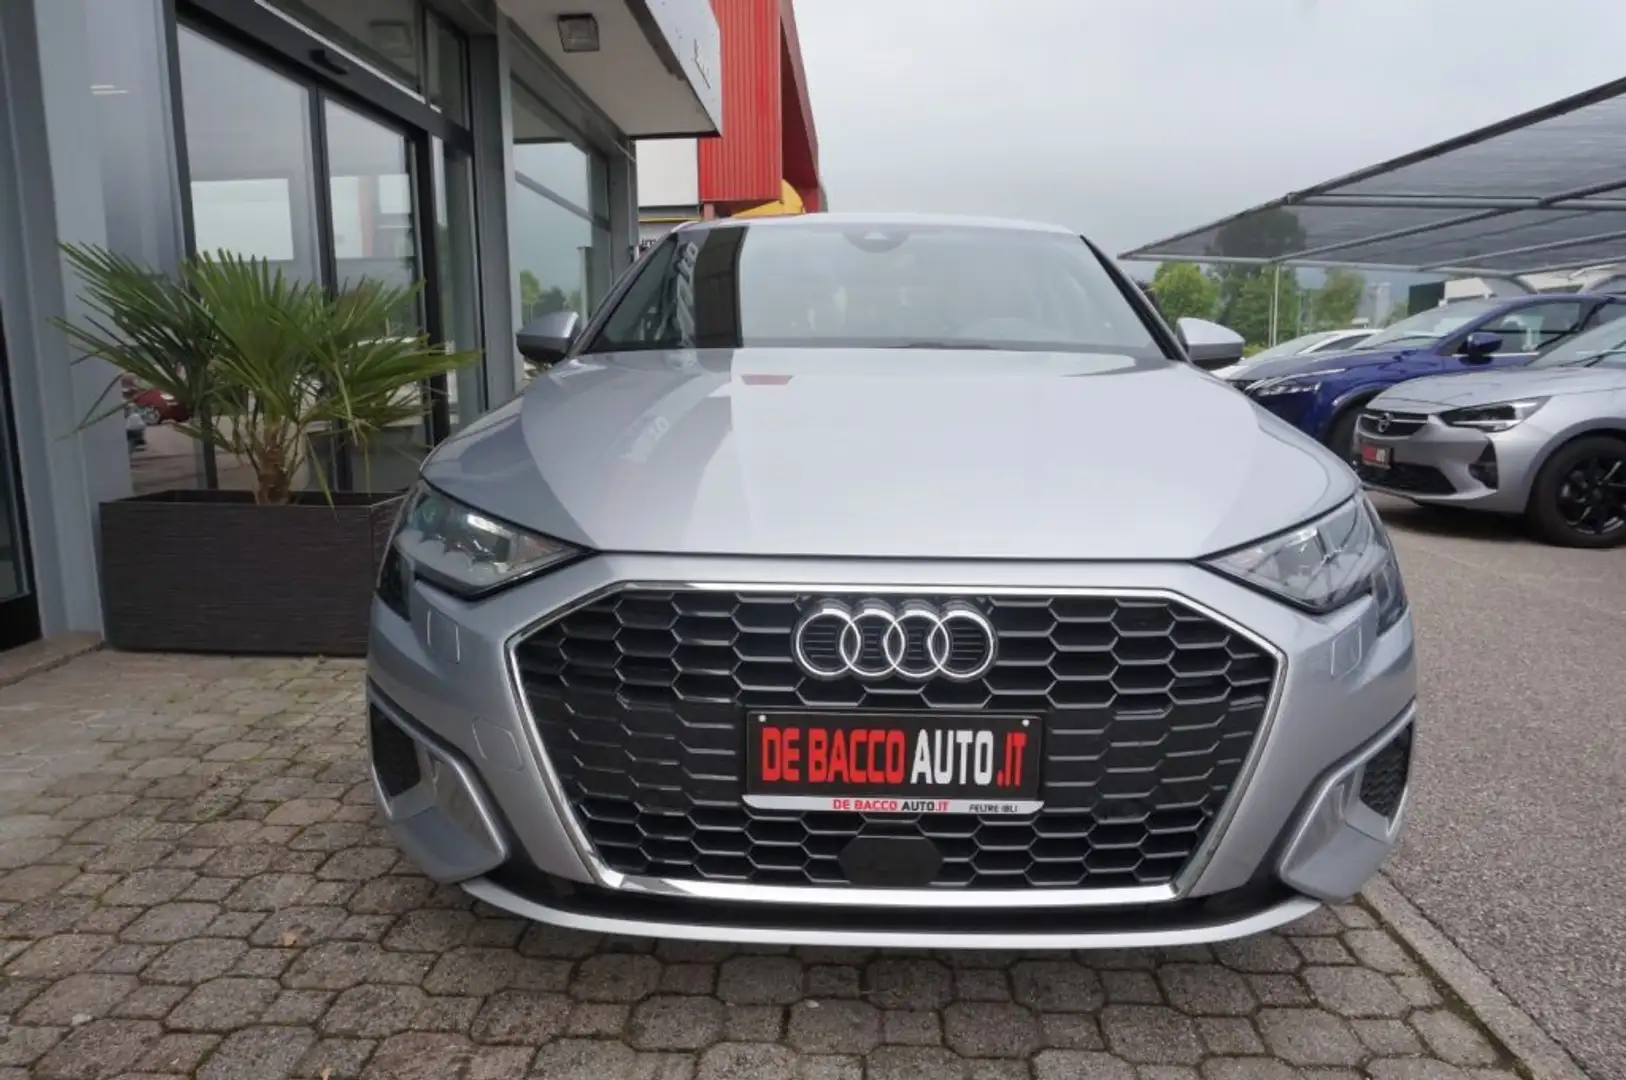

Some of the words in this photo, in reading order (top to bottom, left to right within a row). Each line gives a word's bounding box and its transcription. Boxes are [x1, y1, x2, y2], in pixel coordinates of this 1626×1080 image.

[762, 727, 800, 781] DE
[808, 729, 905, 783] BACCO
[833, 799, 851, 810] DE
[854, 800, 898, 811] BACCO
[901, 801, 949, 812] AUTO.IT
